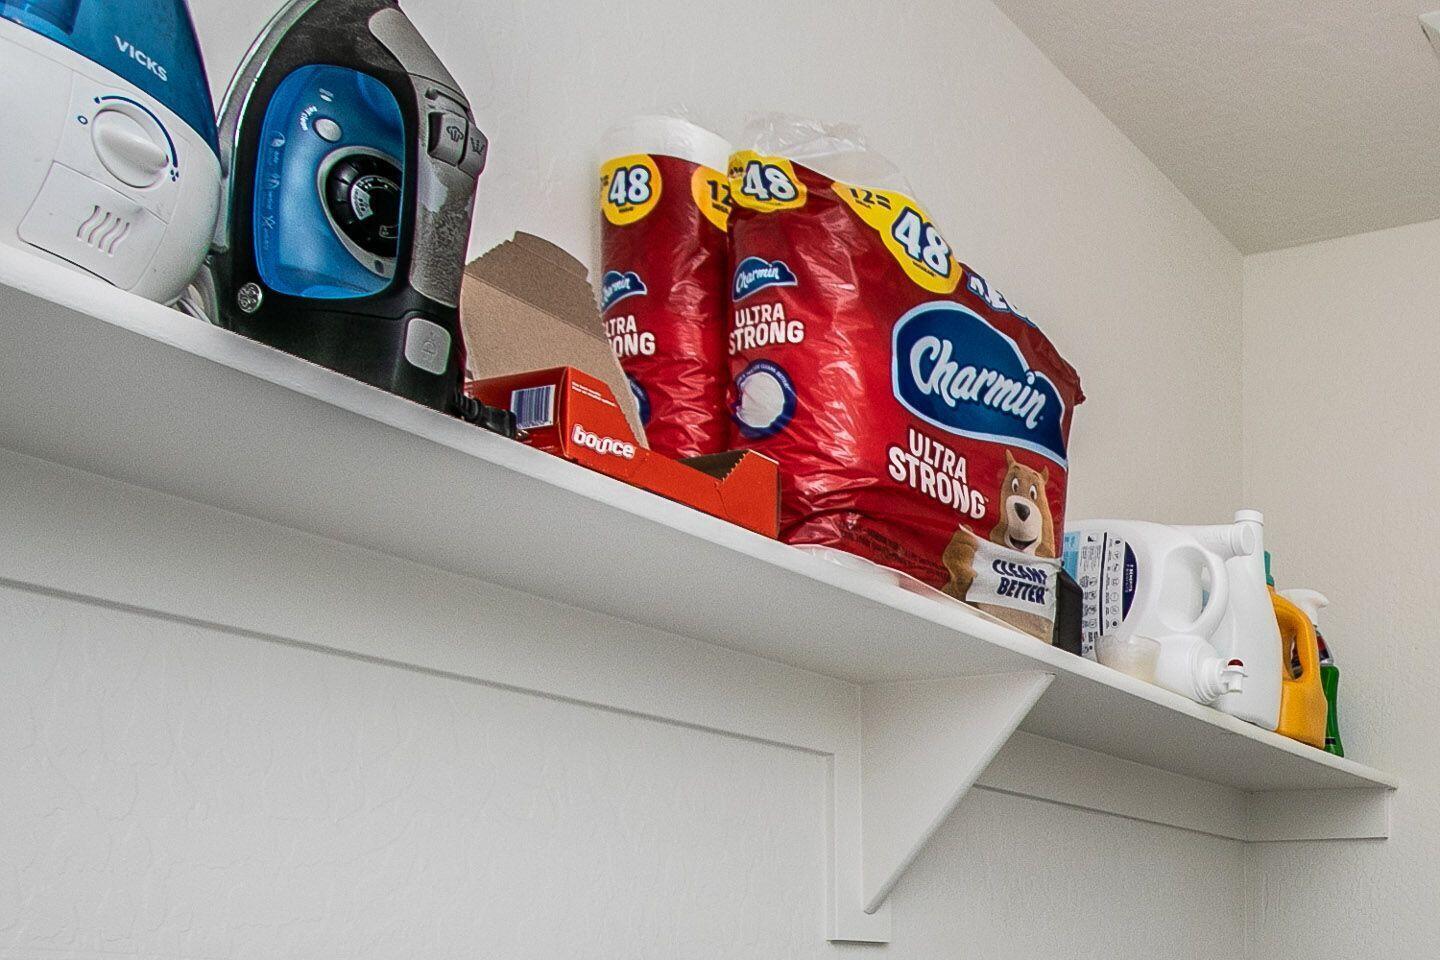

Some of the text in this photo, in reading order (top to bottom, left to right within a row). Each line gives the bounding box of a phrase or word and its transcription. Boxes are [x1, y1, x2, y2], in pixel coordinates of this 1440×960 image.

[113, 35, 168, 82] VICKS
[609, 164, 652, 207] 48
[741, 161, 798, 201] 48
[892, 206, 952, 279] 48
[601, 278, 631, 305] armin
[735, 265, 780, 294] Charmin
[735, 302, 785, 328] ULTRA
[609, 332, 656, 358] ONG
[729, 320, 804, 356] STRONG
[910, 336, 1046, 429] Charmin
[572, 424, 635, 459] bounce
[909, 429, 967, 484] ULTRA
[888, 446, 986, 519] STRONG
[996, 577, 1045, 605] BETTER
